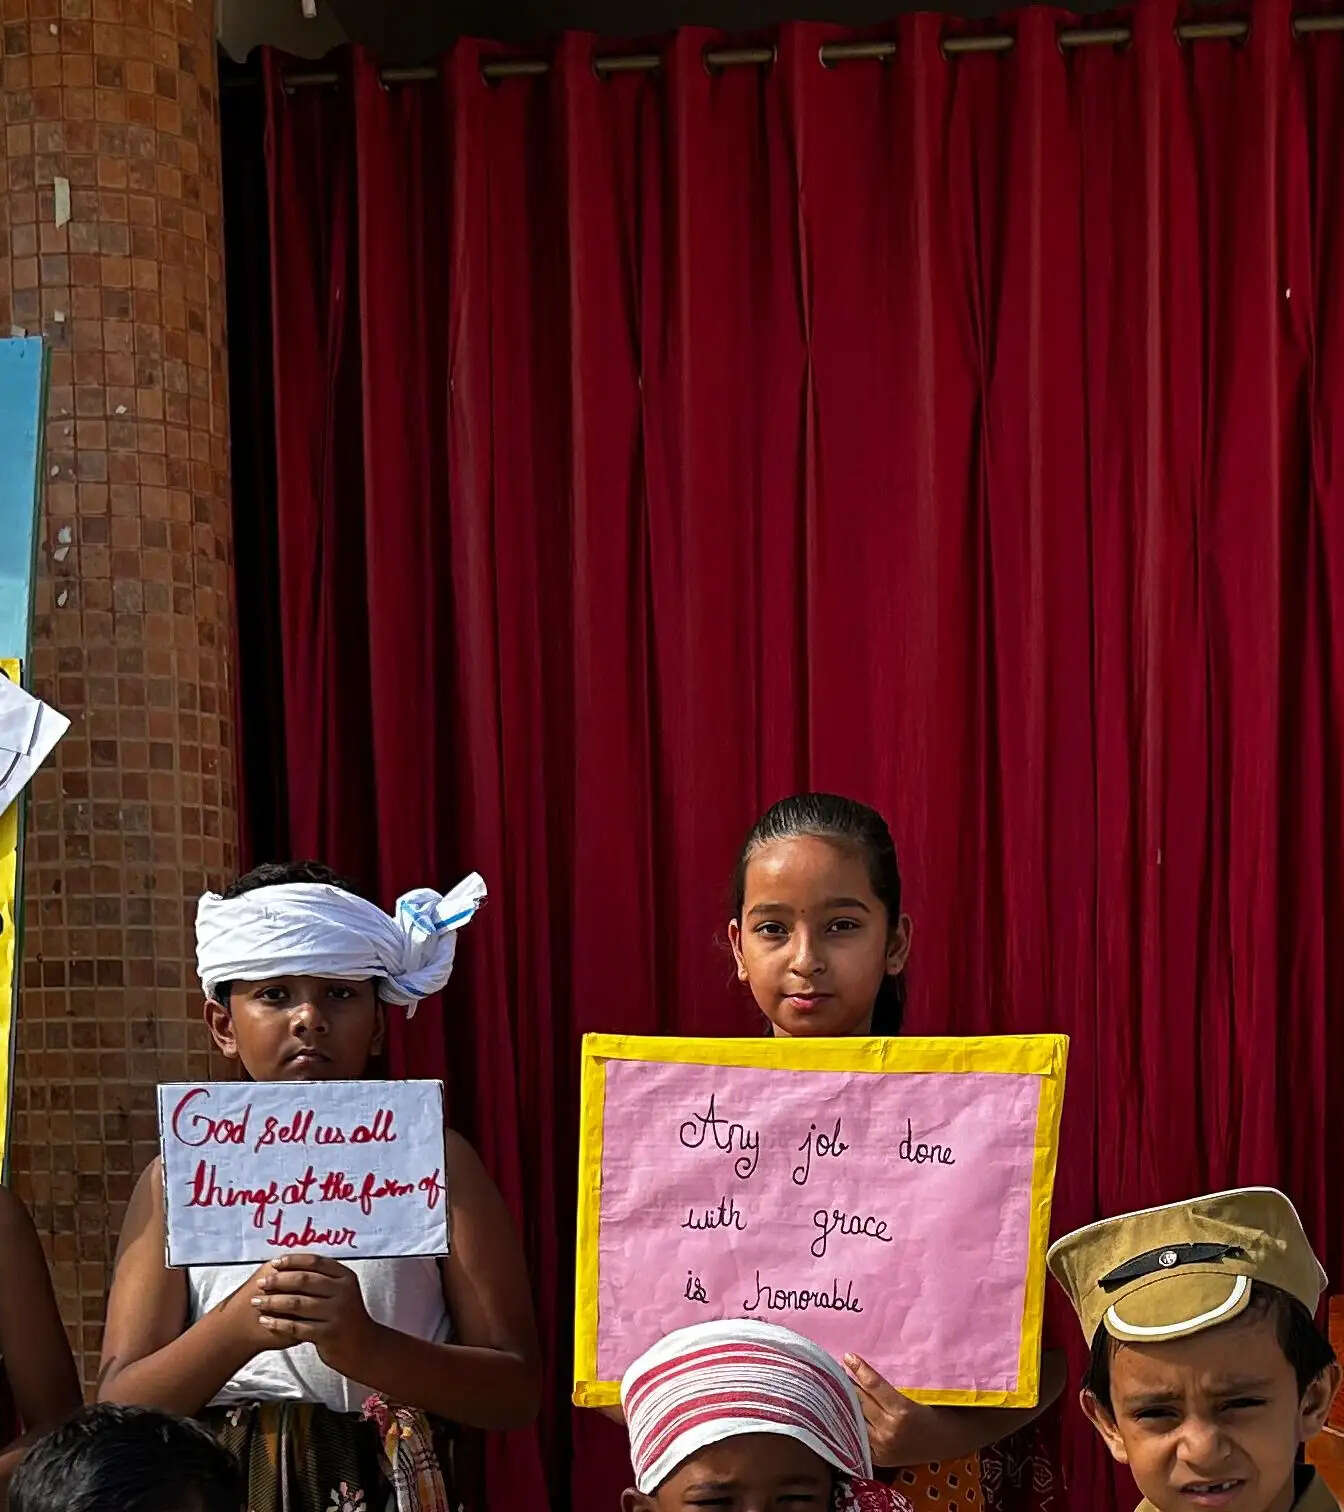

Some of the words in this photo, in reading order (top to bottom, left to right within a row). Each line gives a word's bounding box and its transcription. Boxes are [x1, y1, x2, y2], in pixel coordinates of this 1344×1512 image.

[171, 1088, 253, 1146] God
[315, 1125, 346, 1145] us
[348, 1109, 397, 1145] all
[679, 1094, 760, 1179] Any
[792, 1119, 849, 1185] job
[899, 1118, 956, 1166] done
[184, 1159, 280, 1229] things
[281, 1165, 315, 1205] at
[319, 1171, 357, 1203] the
[418, 1167, 446, 1210] of
[681, 1195, 748, 1231] with
[810, 1207, 893, 1259] grace
[684, 1270, 710, 1304] is
[743, 1270, 864, 1314] honorable
